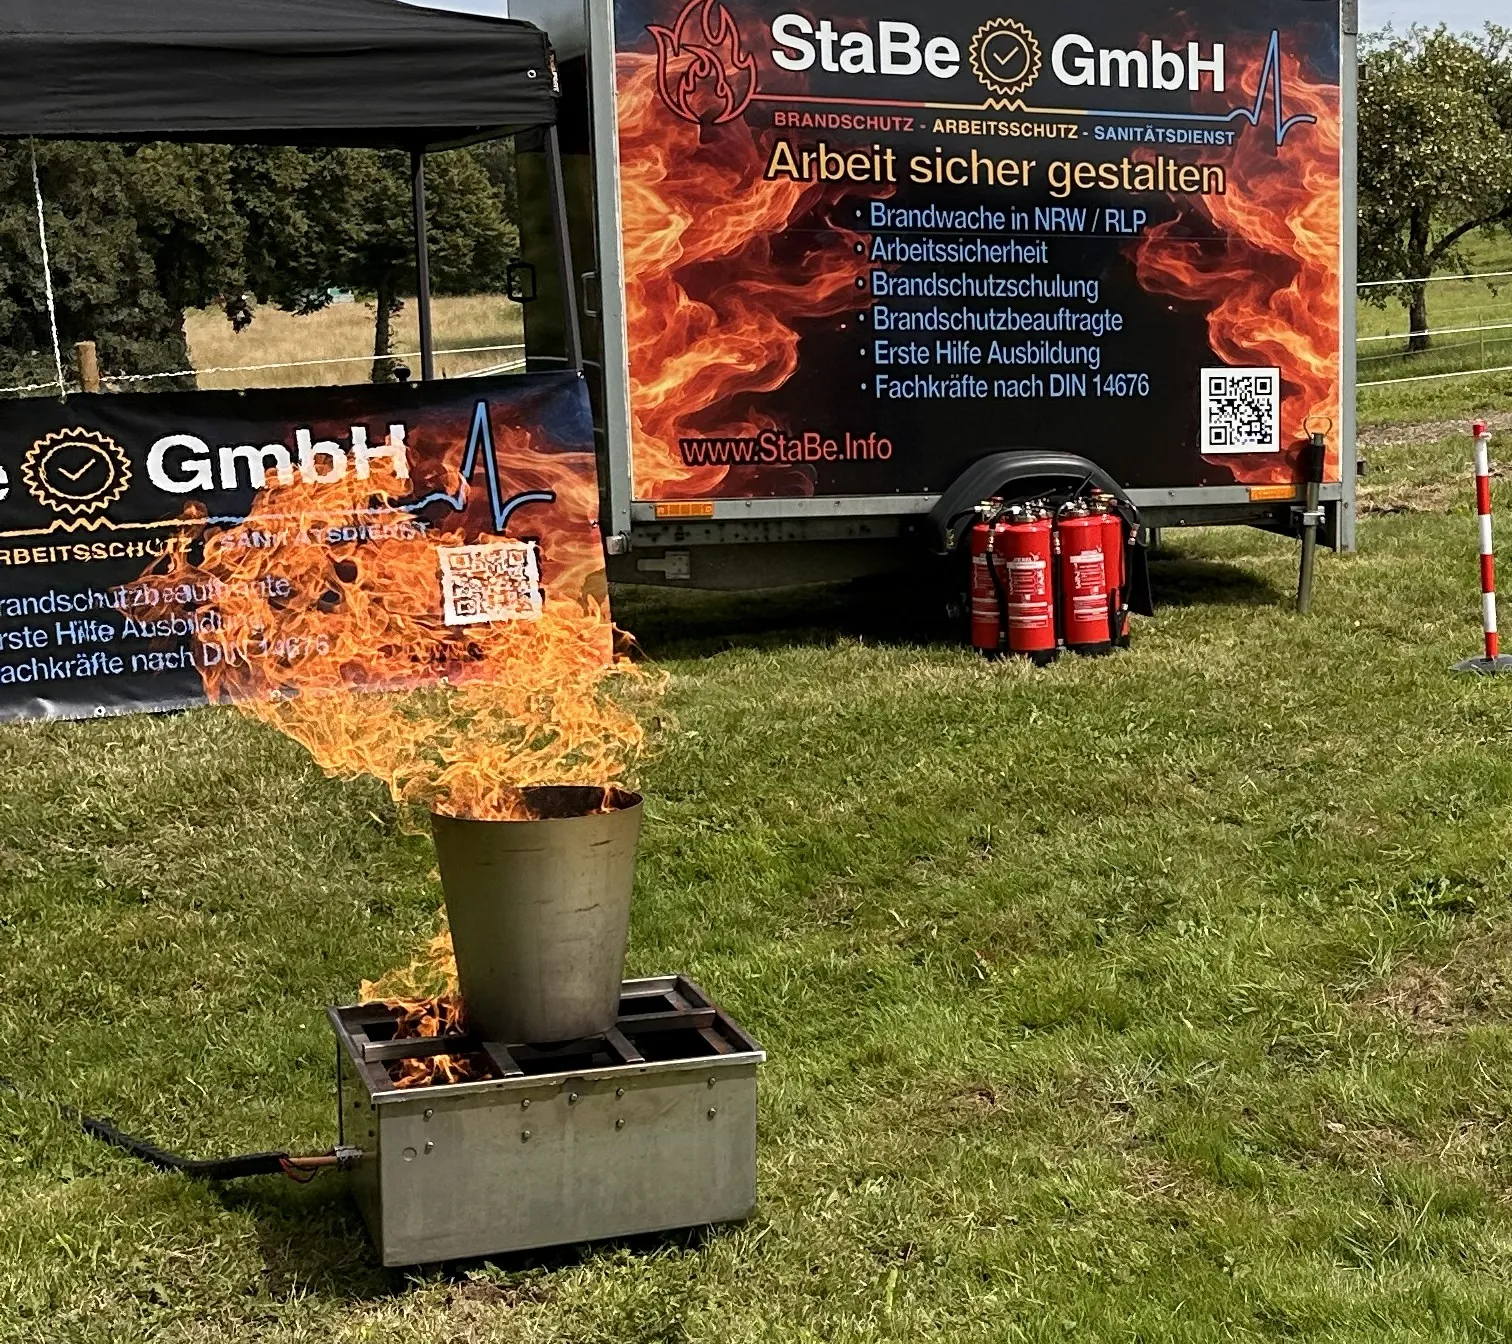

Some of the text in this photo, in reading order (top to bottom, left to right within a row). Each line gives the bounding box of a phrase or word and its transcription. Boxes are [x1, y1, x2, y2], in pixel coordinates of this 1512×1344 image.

[771, 13, 1226, 92] StaBe GmbH
[774, 111, 914, 133] BRANDSCHUTZ
[932, 119, 1078, 139] ARBEITSSCHUTZ
[1094, 124, 1235, 146] SANITÄTSDIENST
[766, 140, 1225, 198] Arbeit sicher gestalten
[870, 201, 1147, 233] Brandwache in NRW / RLP
[870, 236, 1049, 264] Arbeitssicherheit
[872, 270, 1099, 304] Brandschutzschulung
[873, 305, 1124, 337] Brandschutzbeauftragte
[874, 339, 1101, 370] Erste Hilfe Ausbildung
[875, 372, 1150, 399] Fachkräfte nach DIN 14676
[145, 423, 412, 495] GmbH
[682, 431, 893, 463] www.StaBe.Info
[55, 618, 116, 646] Hilfe
[131, 644, 197, 674] nach
